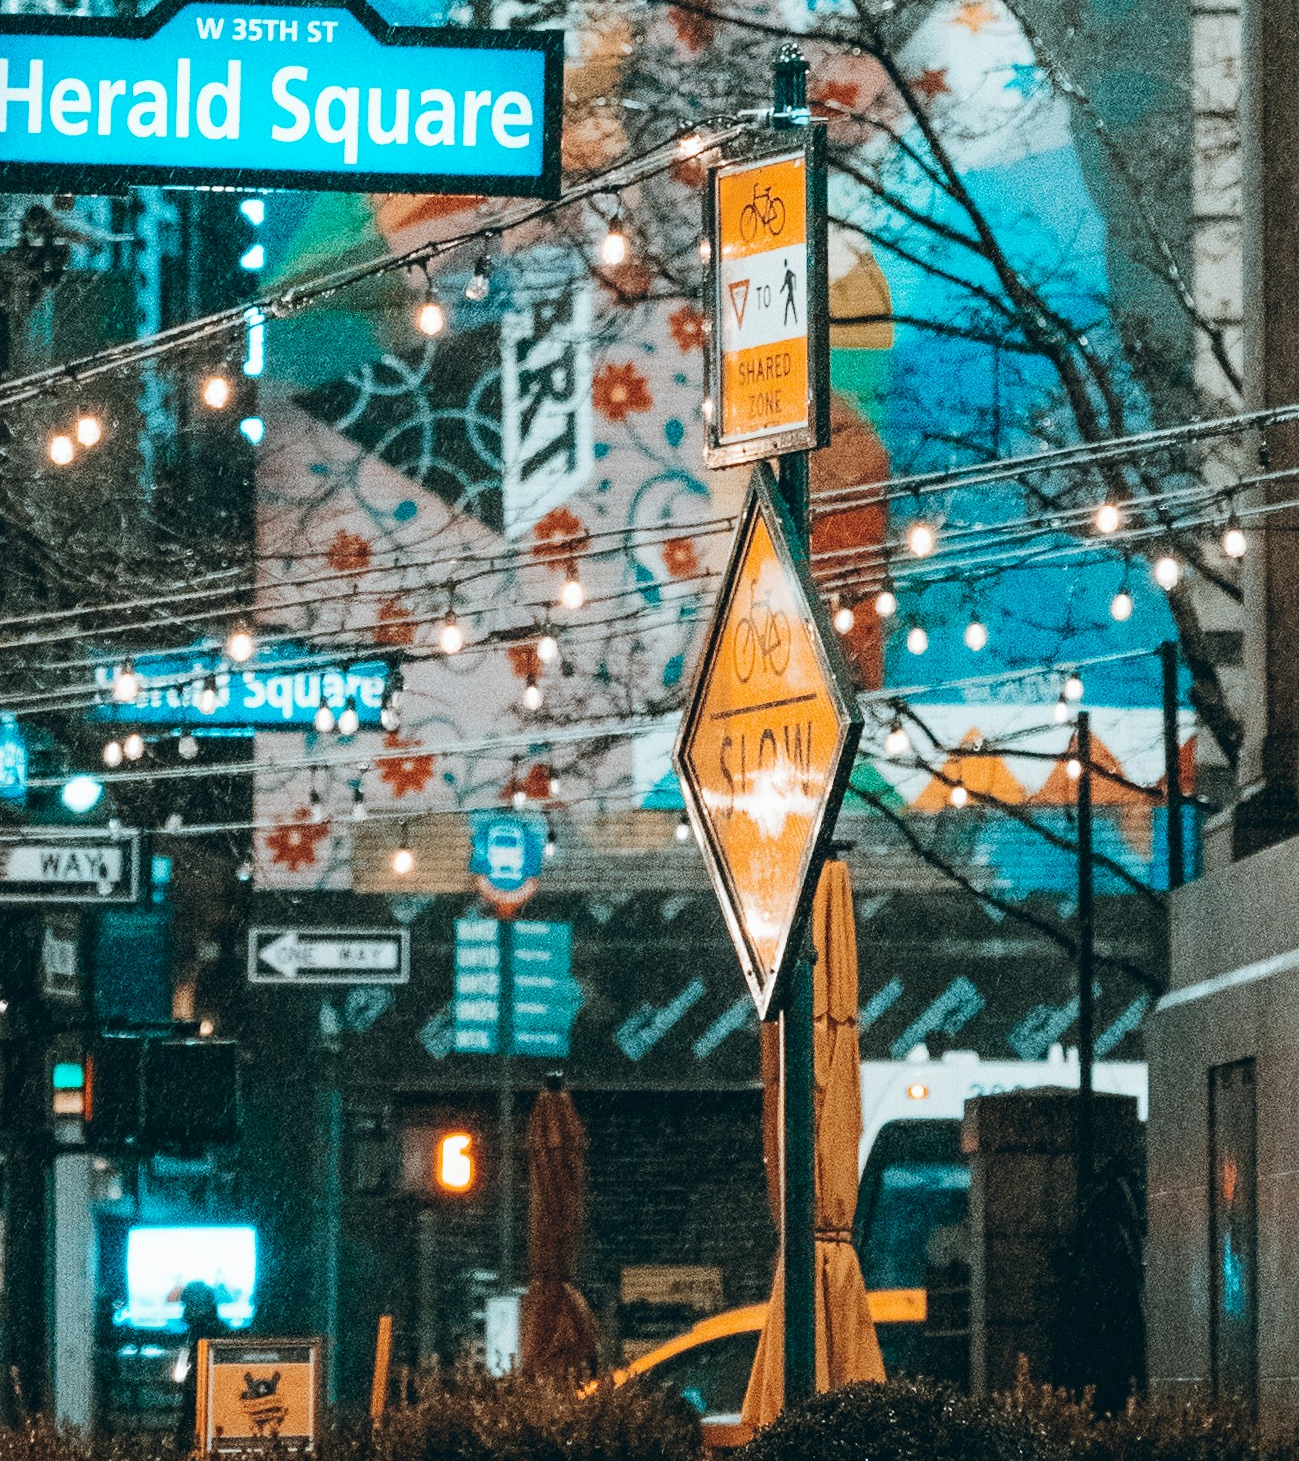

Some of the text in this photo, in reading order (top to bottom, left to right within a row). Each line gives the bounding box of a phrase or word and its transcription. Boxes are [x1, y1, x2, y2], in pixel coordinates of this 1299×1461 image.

[197, 17, 338, 43] W 35TH ST
[271, 64, 534, 165] Square
[756, 285, 772, 309] TO
[738, 353, 792, 386] SHARED
[749, 391, 782, 419] ZONE
[243, 669, 385, 720] Square
[719, 721, 814, 820] SLOW
[39, 850, 103, 878] WAY
[274, 945, 316, 966] ONE
[441, 1135, 471, 1187] 6
